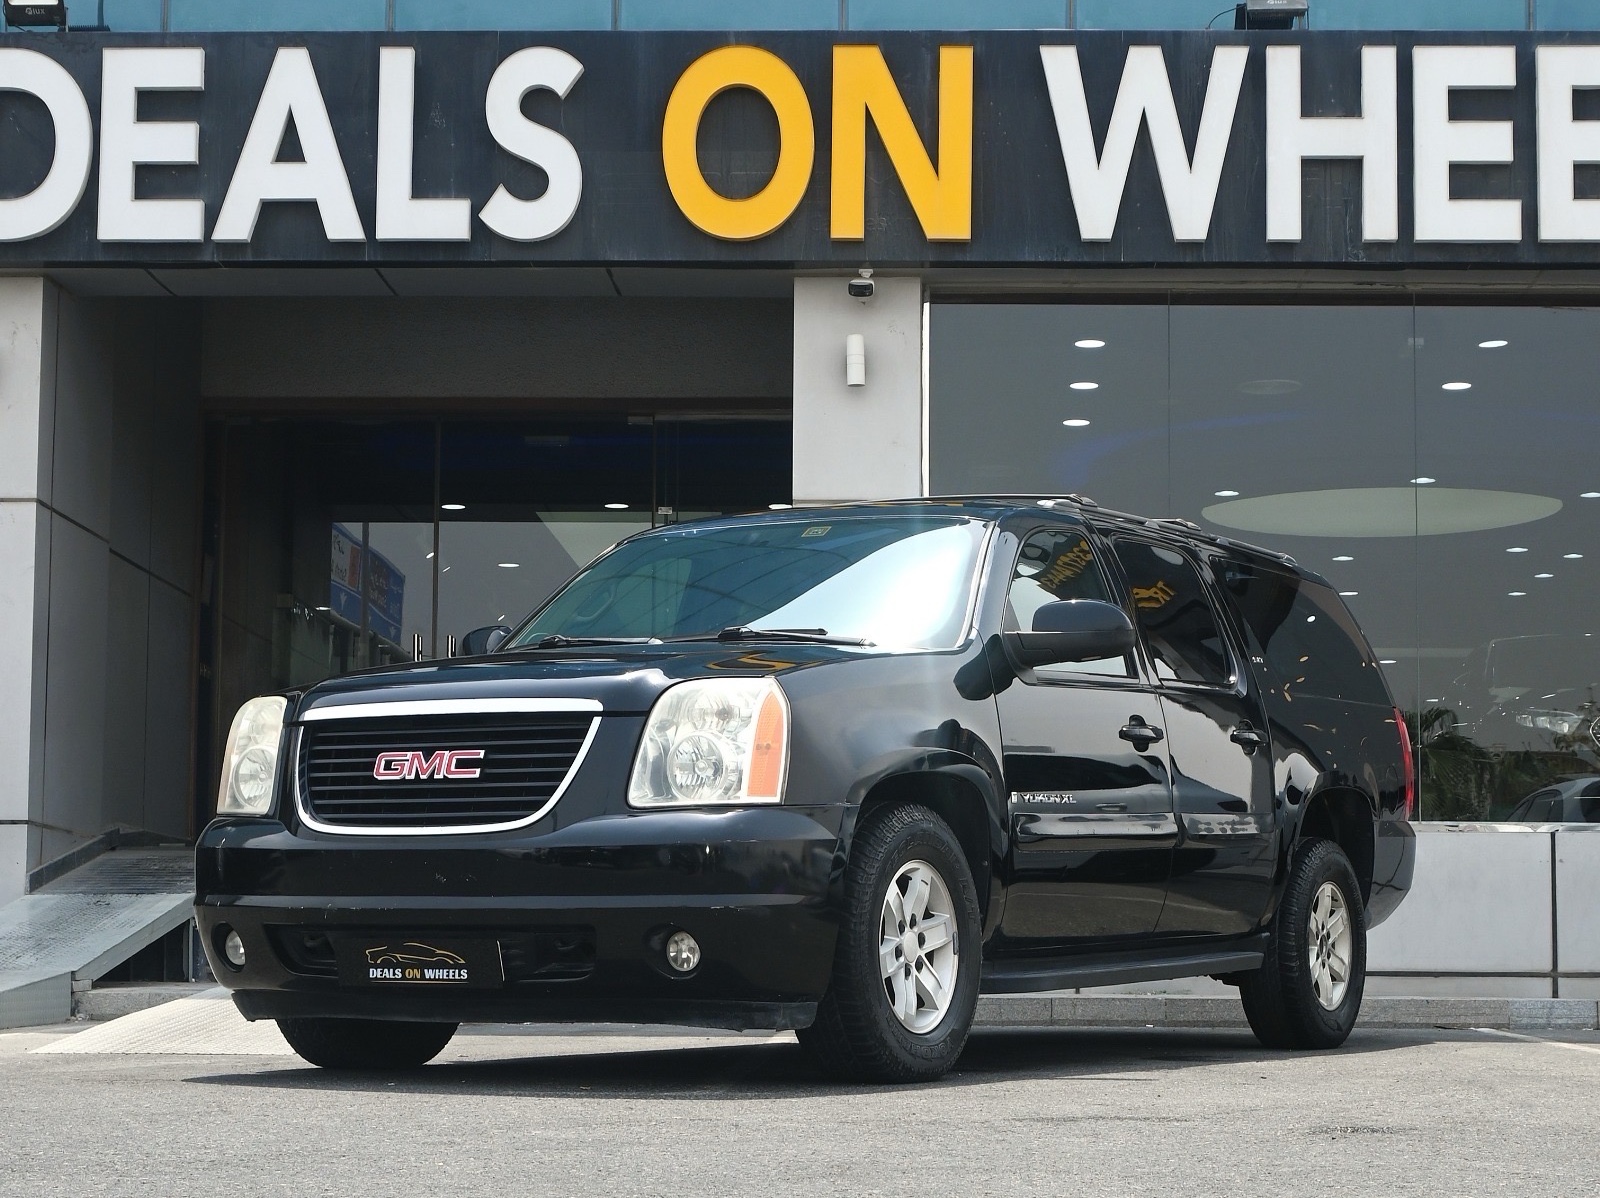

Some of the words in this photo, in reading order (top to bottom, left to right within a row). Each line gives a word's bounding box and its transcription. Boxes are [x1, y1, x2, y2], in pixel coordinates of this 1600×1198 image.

[0, 45, 585, 243] DEALS
[662, 44, 974, 242] ON
[1039, 44, 1600, 243] WHEE
[373, 749, 486, 780] GMC
[1021, 792, 1061, 804] YUKON
[1061, 794, 1077, 804] XL
[369, 968, 402, 979] DEALS
[405, 968, 421, 979] ON
[424, 968, 468, 980] WHEELS
